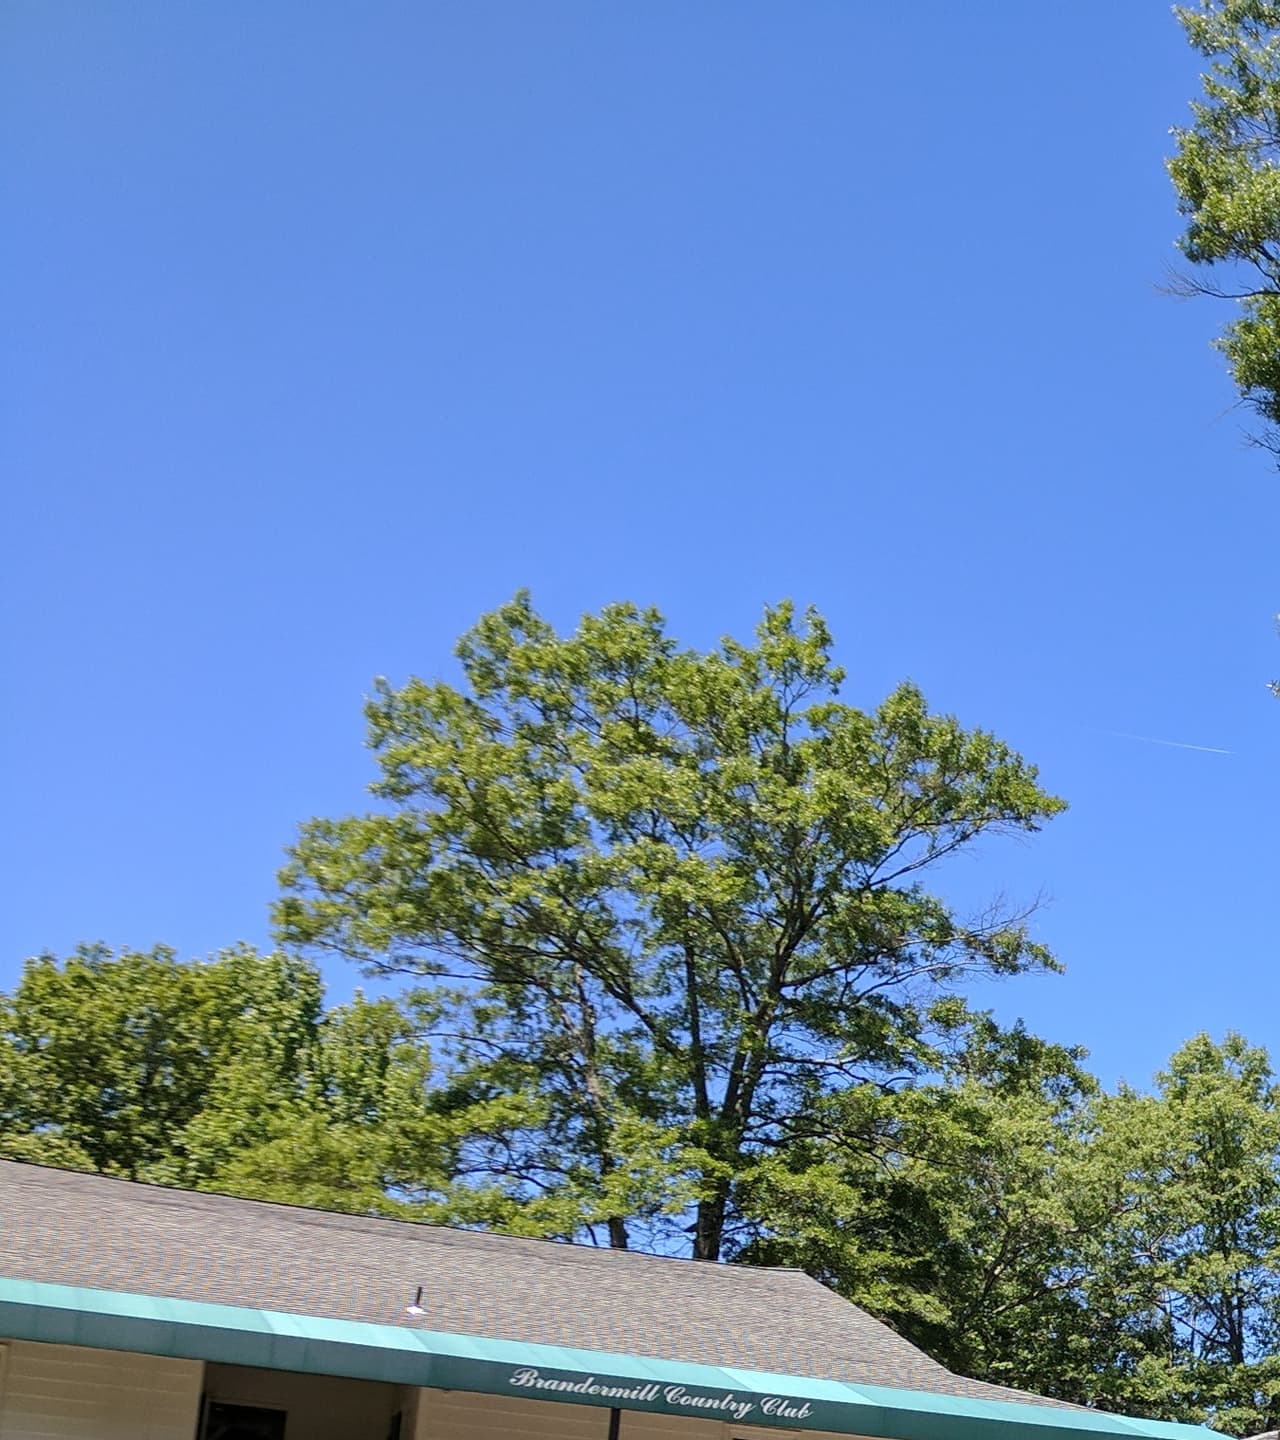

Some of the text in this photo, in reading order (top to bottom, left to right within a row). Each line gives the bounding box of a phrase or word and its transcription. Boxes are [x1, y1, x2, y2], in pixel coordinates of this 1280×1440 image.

[509, 1367, 813, 1419] Brandermill Country Club
